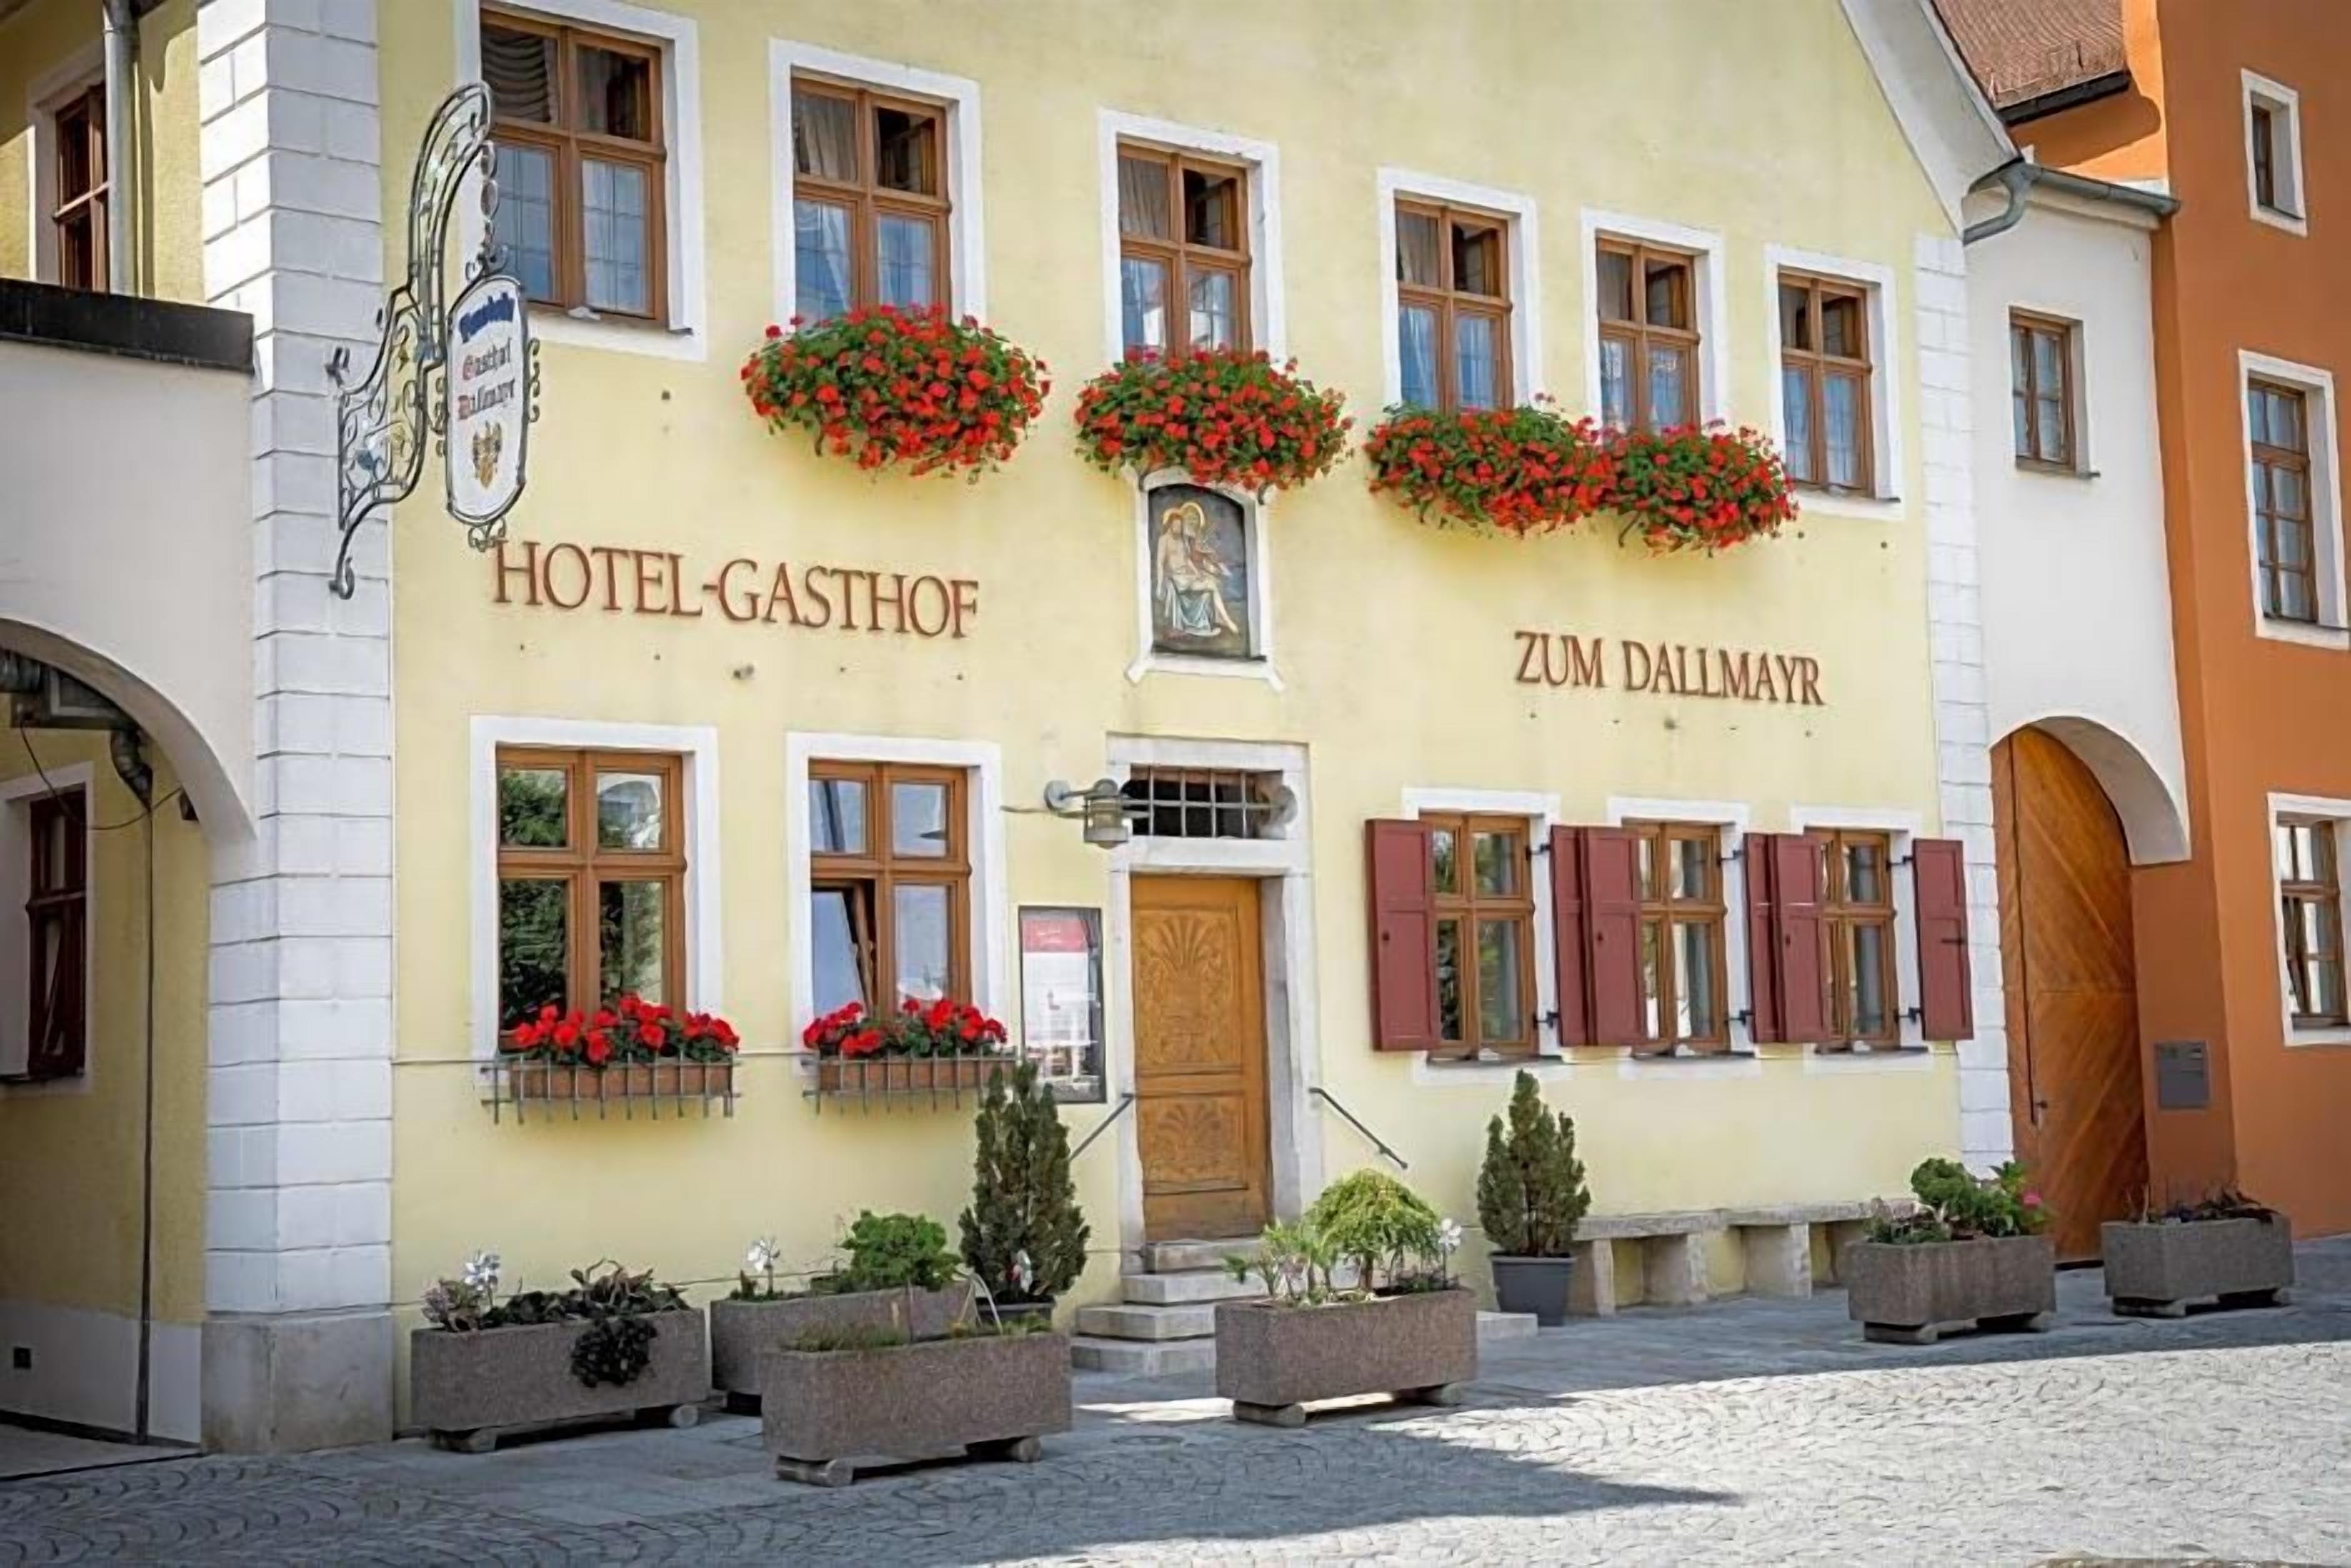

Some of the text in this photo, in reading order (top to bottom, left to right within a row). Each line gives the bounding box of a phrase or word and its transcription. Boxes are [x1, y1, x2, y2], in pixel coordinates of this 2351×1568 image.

[493, 540, 979, 639] HOTEL-GASTHOF
[1514, 630, 1825, 705] ZUM DALLMAYR
